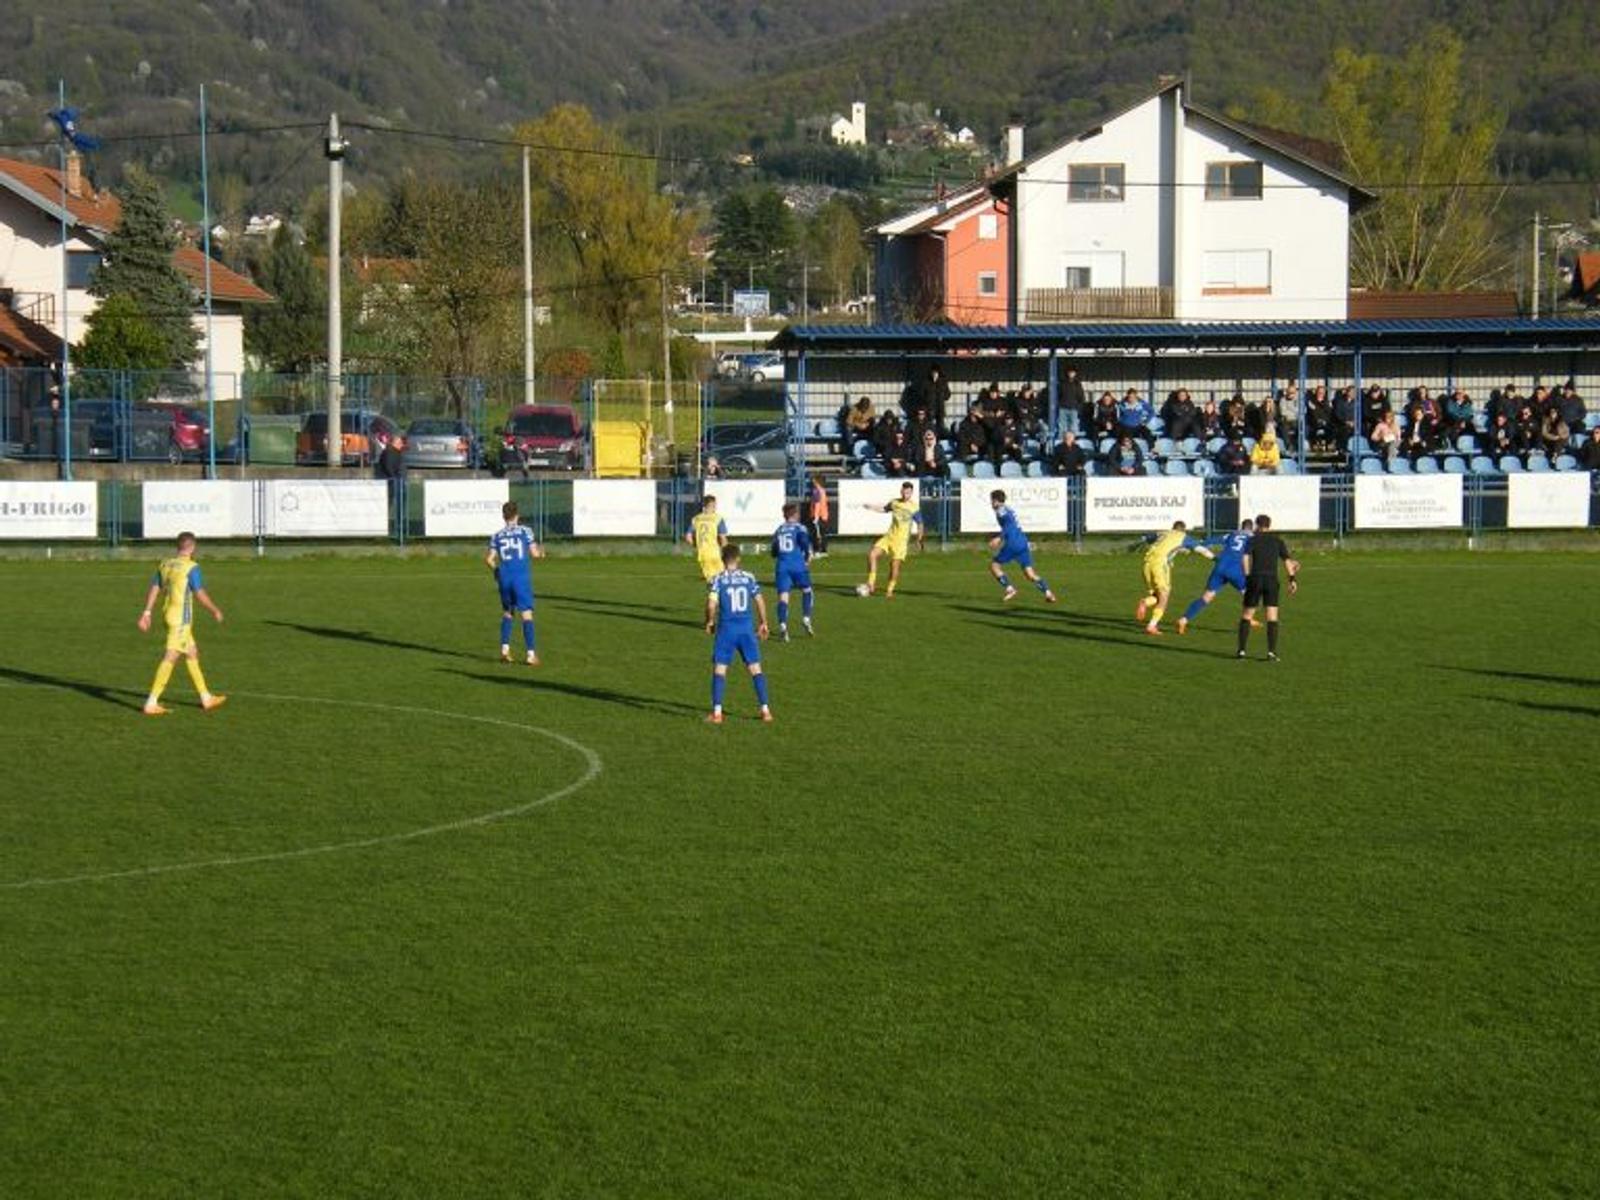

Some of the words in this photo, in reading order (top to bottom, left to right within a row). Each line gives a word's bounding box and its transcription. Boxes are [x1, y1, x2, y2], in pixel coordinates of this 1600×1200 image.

[1160, 495, 1187, 508] KAJ
[500, 537, 523, 561] 24
[777, 533, 794, 552] 16
[1231, 535, 1246, 552] 5
[727, 586, 748, 613] 10
